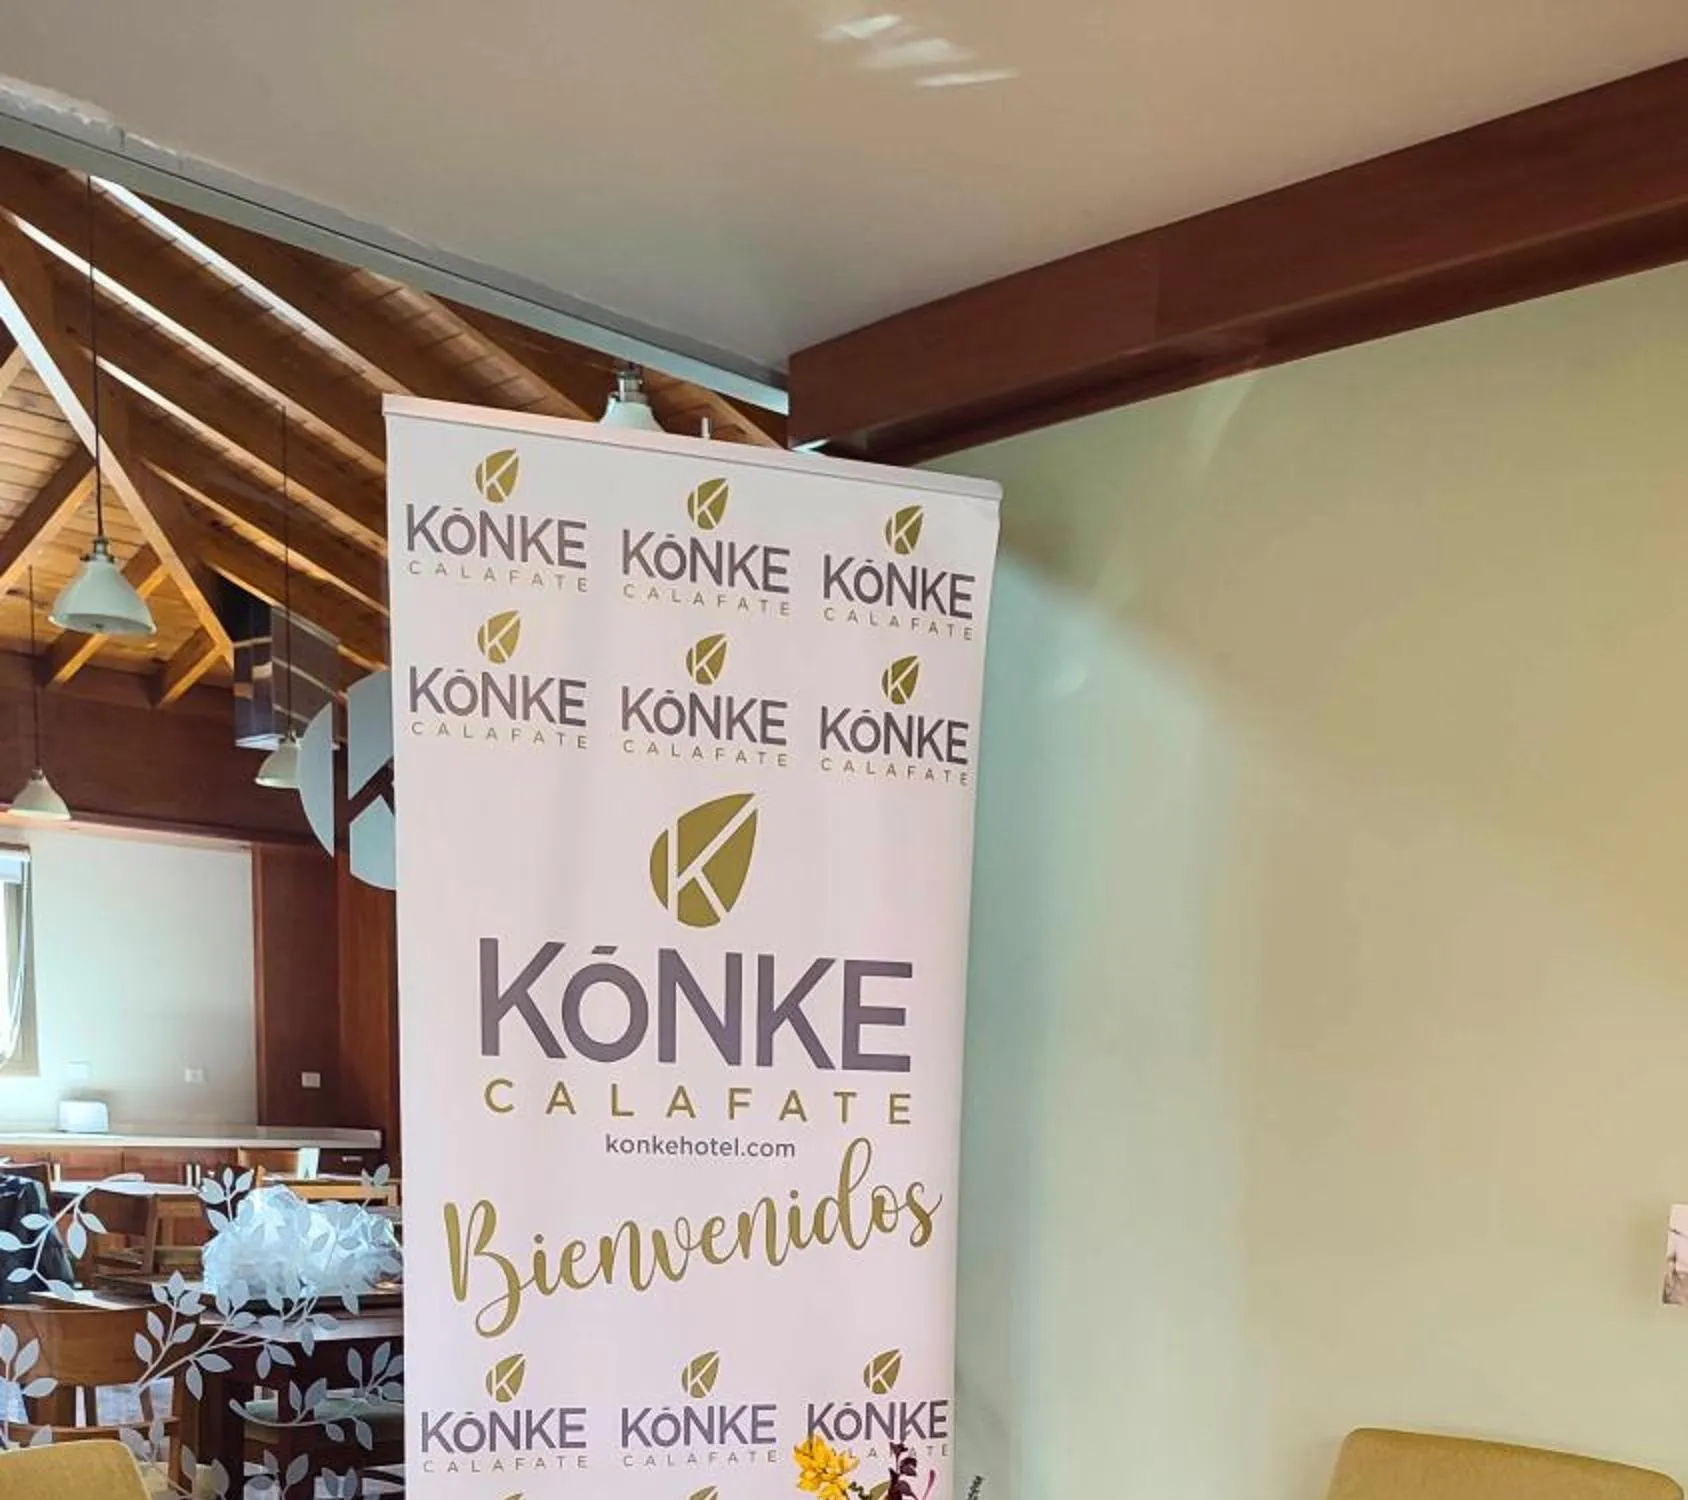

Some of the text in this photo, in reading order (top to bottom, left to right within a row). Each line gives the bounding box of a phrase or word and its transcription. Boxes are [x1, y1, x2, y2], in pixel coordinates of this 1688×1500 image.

[409, 560, 588, 593] CALAFATE
[623, 584, 790, 616] CALAFATE
[824, 608, 972, 641] CALAFATE
[411, 721, 587, 749] CALAFATE
[623, 739, 788, 767] CALAFATE
[821, 758, 968, 786] CALAFATE
[484, 1078, 911, 1125] CALAFATE
[606, 1133, 796, 1157] konkehotel.com
[443, 1137, 943, 1338] Bienvenidos
[423, 1455, 588, 1473] CALAFATE
[623, 1449, 777, 1467] CALAFATE
